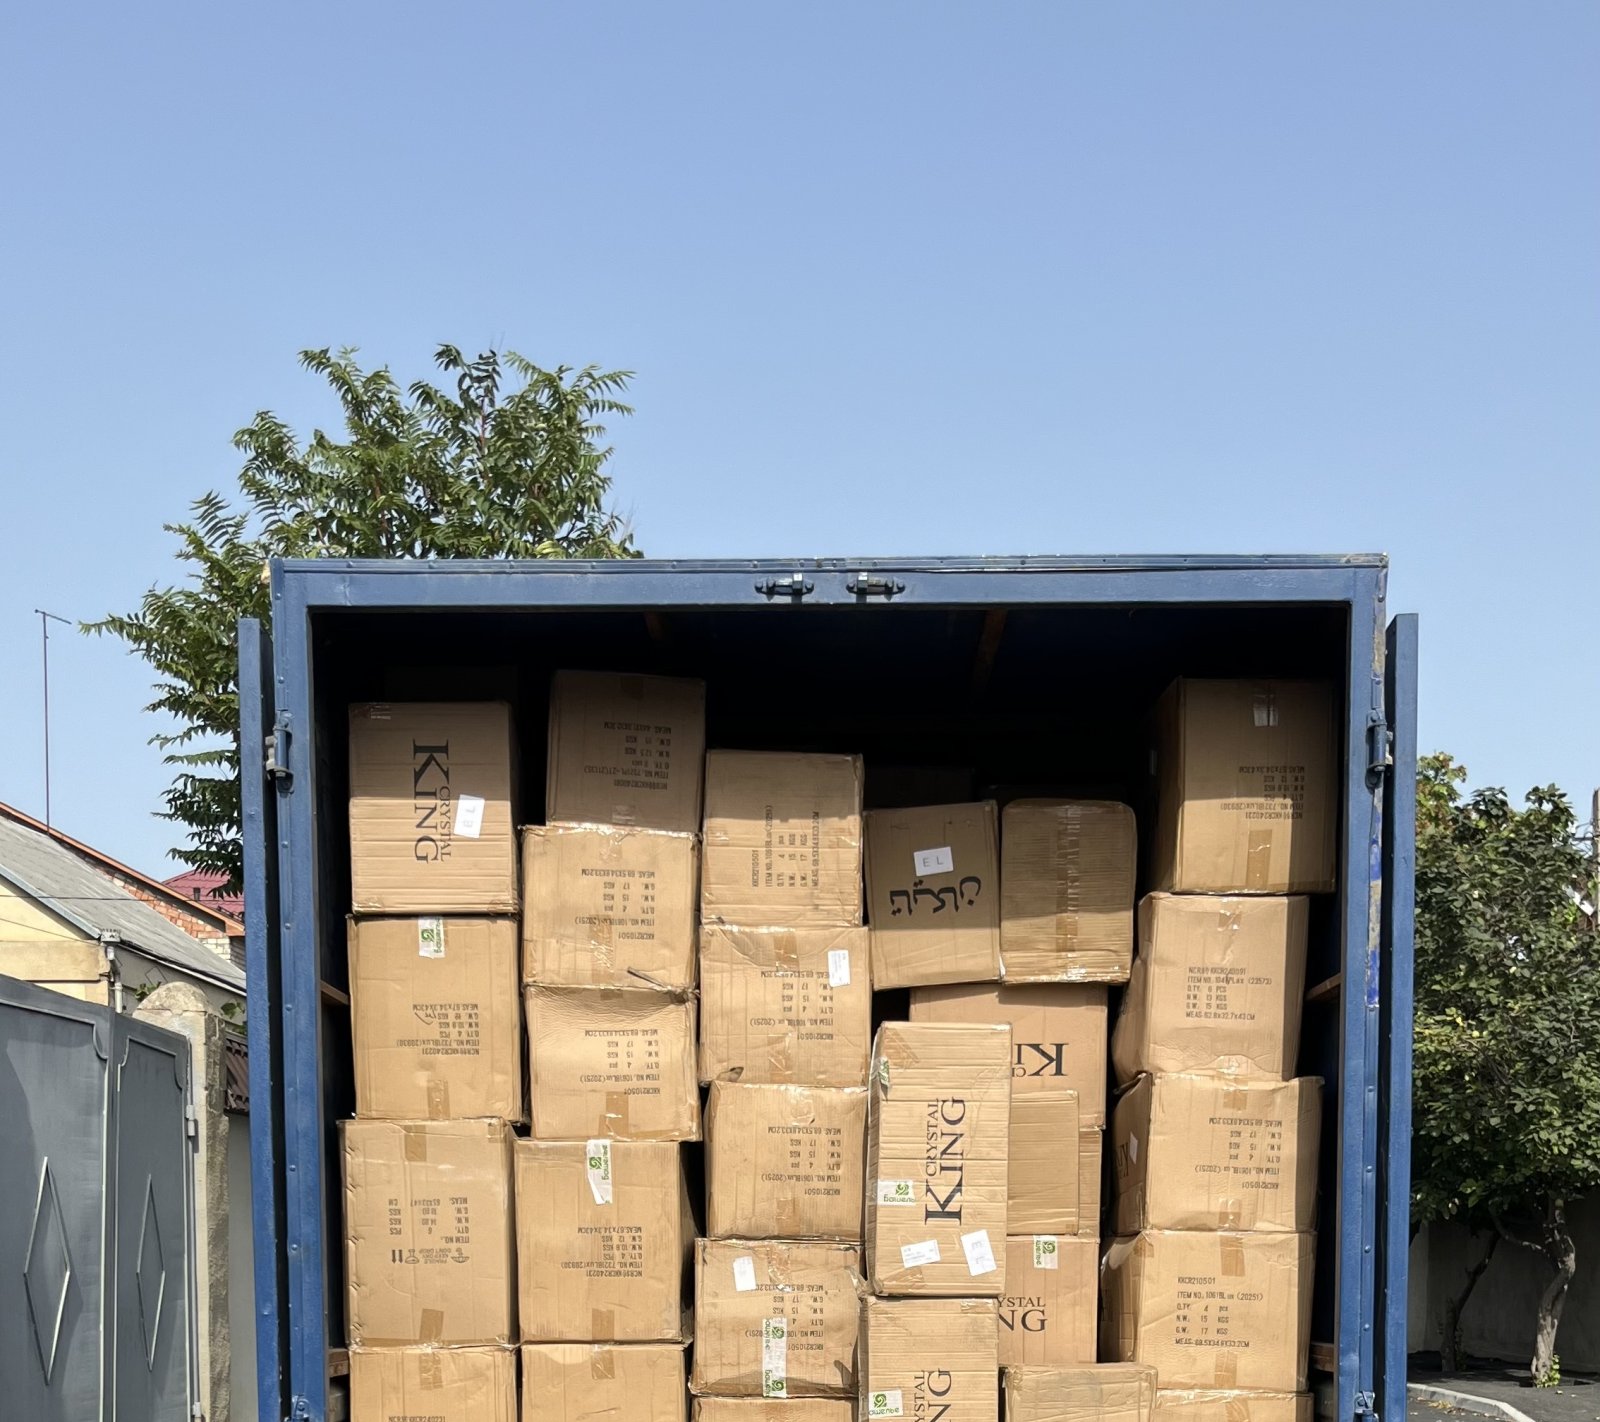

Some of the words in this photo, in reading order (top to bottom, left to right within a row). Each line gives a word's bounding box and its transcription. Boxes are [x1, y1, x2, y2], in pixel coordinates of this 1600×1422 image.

[413, 738, 449, 864] KING
[439, 786, 452, 862] CRYSTAL
[1014, 1044, 1069, 1077] KI
[925, 1096, 965, 1226] KING
[926, 1098, 939, 1177] CRYSTAL
[996, 1297, 1046, 1308] YSTAL
[998, 1309, 1048, 1332] NG
[1201, 1315, 1207, 1323] 15
